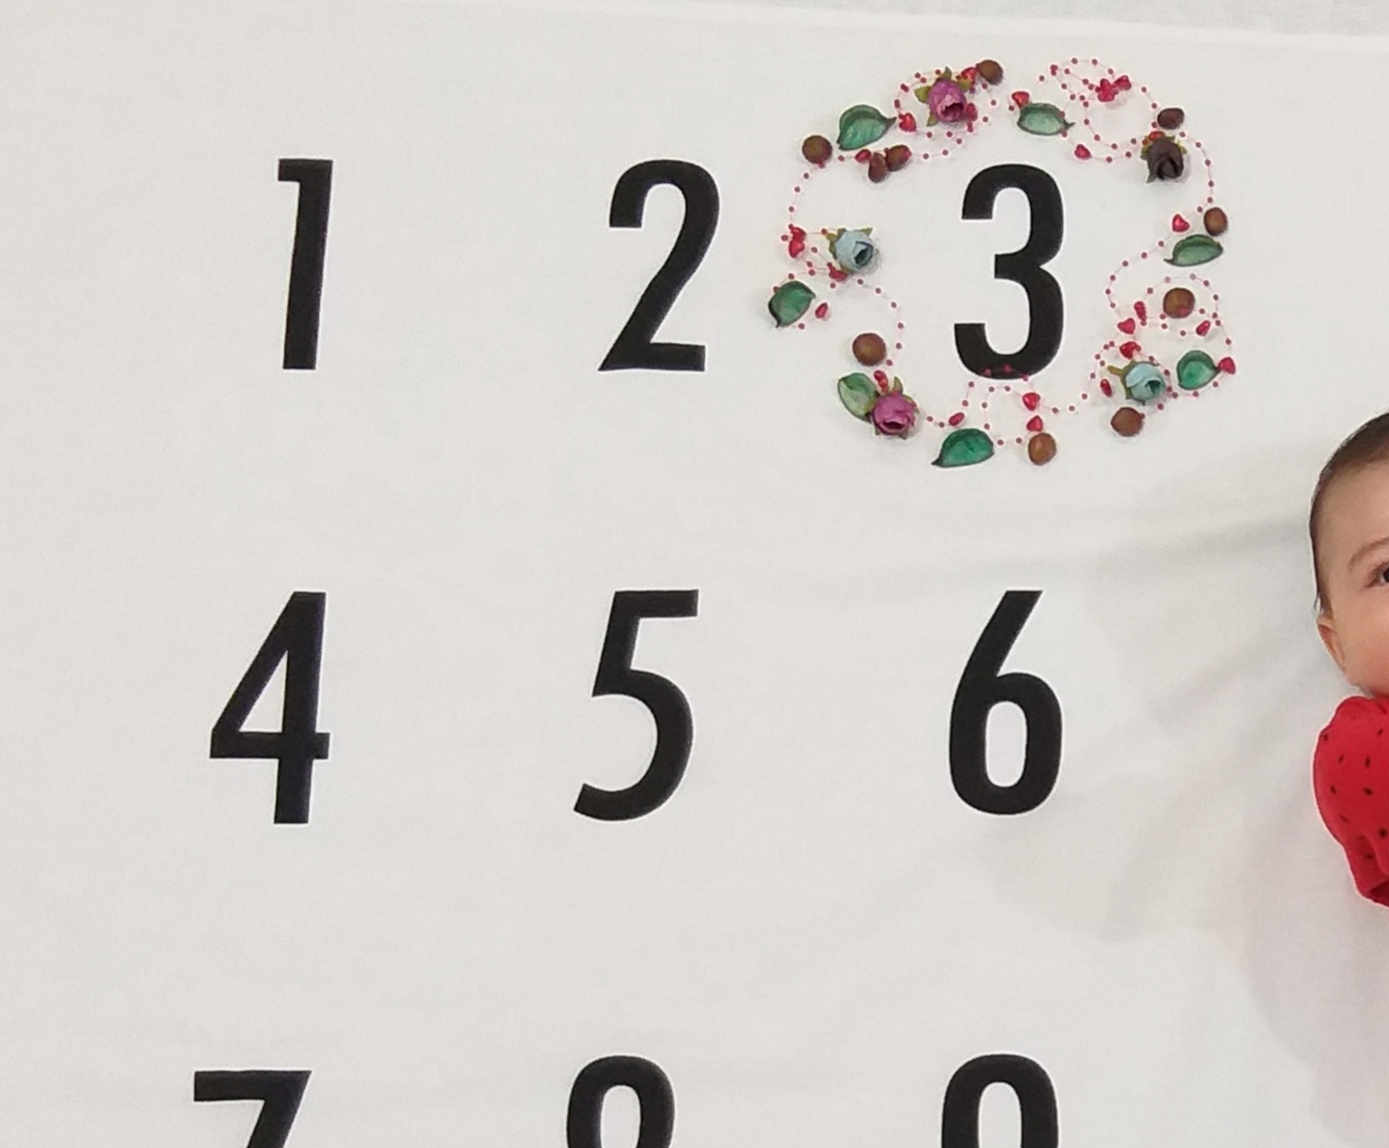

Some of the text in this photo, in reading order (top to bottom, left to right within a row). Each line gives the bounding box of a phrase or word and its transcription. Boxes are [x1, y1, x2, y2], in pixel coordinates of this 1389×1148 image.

[278, 159, 1063, 380] 1 2 3
[210, 590, 1062, 824] 4 5 6
